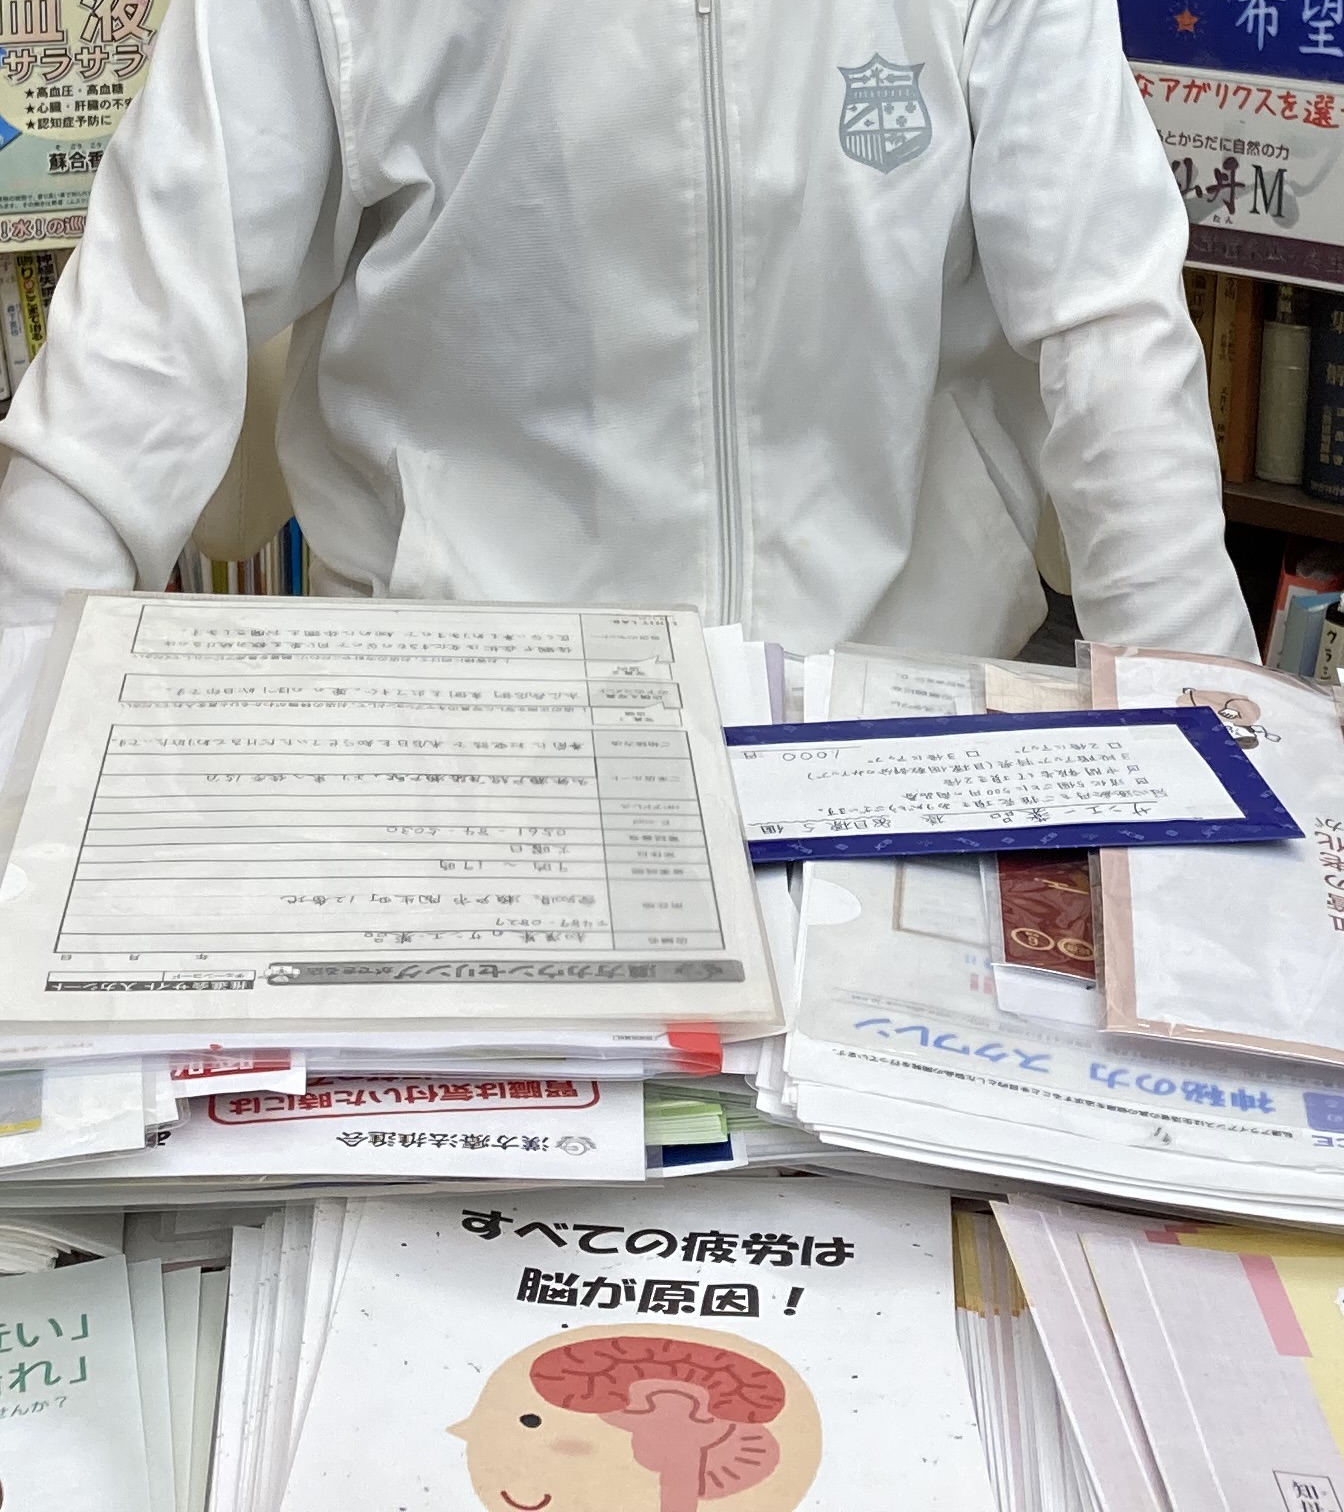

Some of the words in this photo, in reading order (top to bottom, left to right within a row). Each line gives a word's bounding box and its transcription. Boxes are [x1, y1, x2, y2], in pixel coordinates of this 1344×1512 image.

[2, 44, 148, 83] サラサラ
[854, 1018, 1051, 1076] スクワレン
[1088, 1062, 1275, 1115] 神秘の力
[336, 1131, 550, 1153] 漢方療法推進会
[461, 1209, 855, 1267] すべての疲労は
